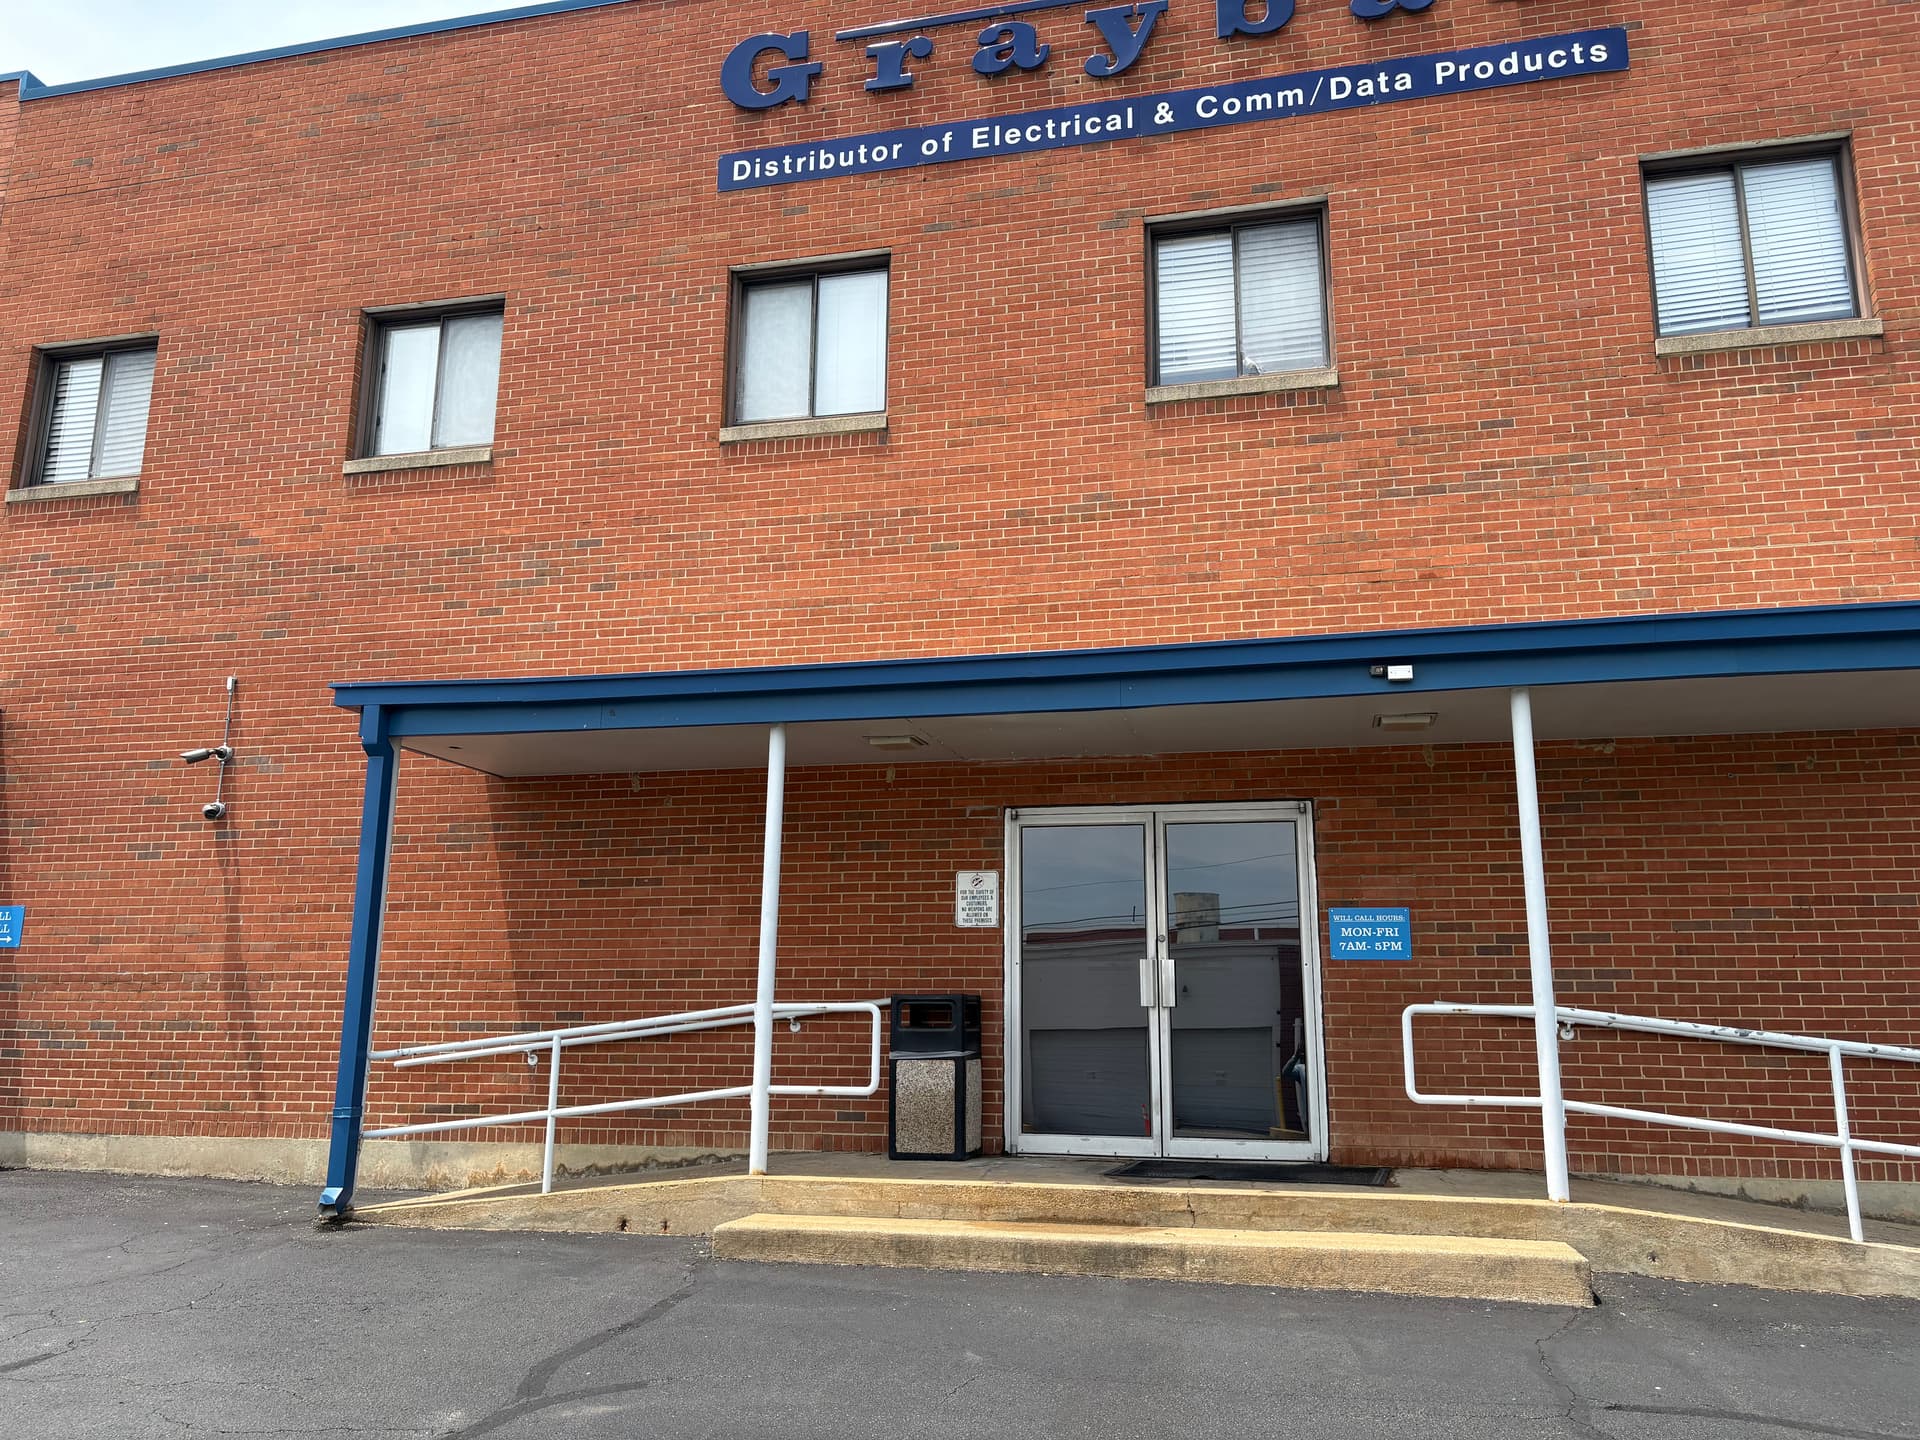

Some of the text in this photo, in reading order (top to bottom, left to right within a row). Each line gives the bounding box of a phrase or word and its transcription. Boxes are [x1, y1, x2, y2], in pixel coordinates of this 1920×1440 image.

[732, 41, 1609, 182] Distributor of Electrical & Comm/Data Products
[1341, 927, 1400, 937] MON-FRI
[1339, 941, 1403, 951] 7AM- 5PM
